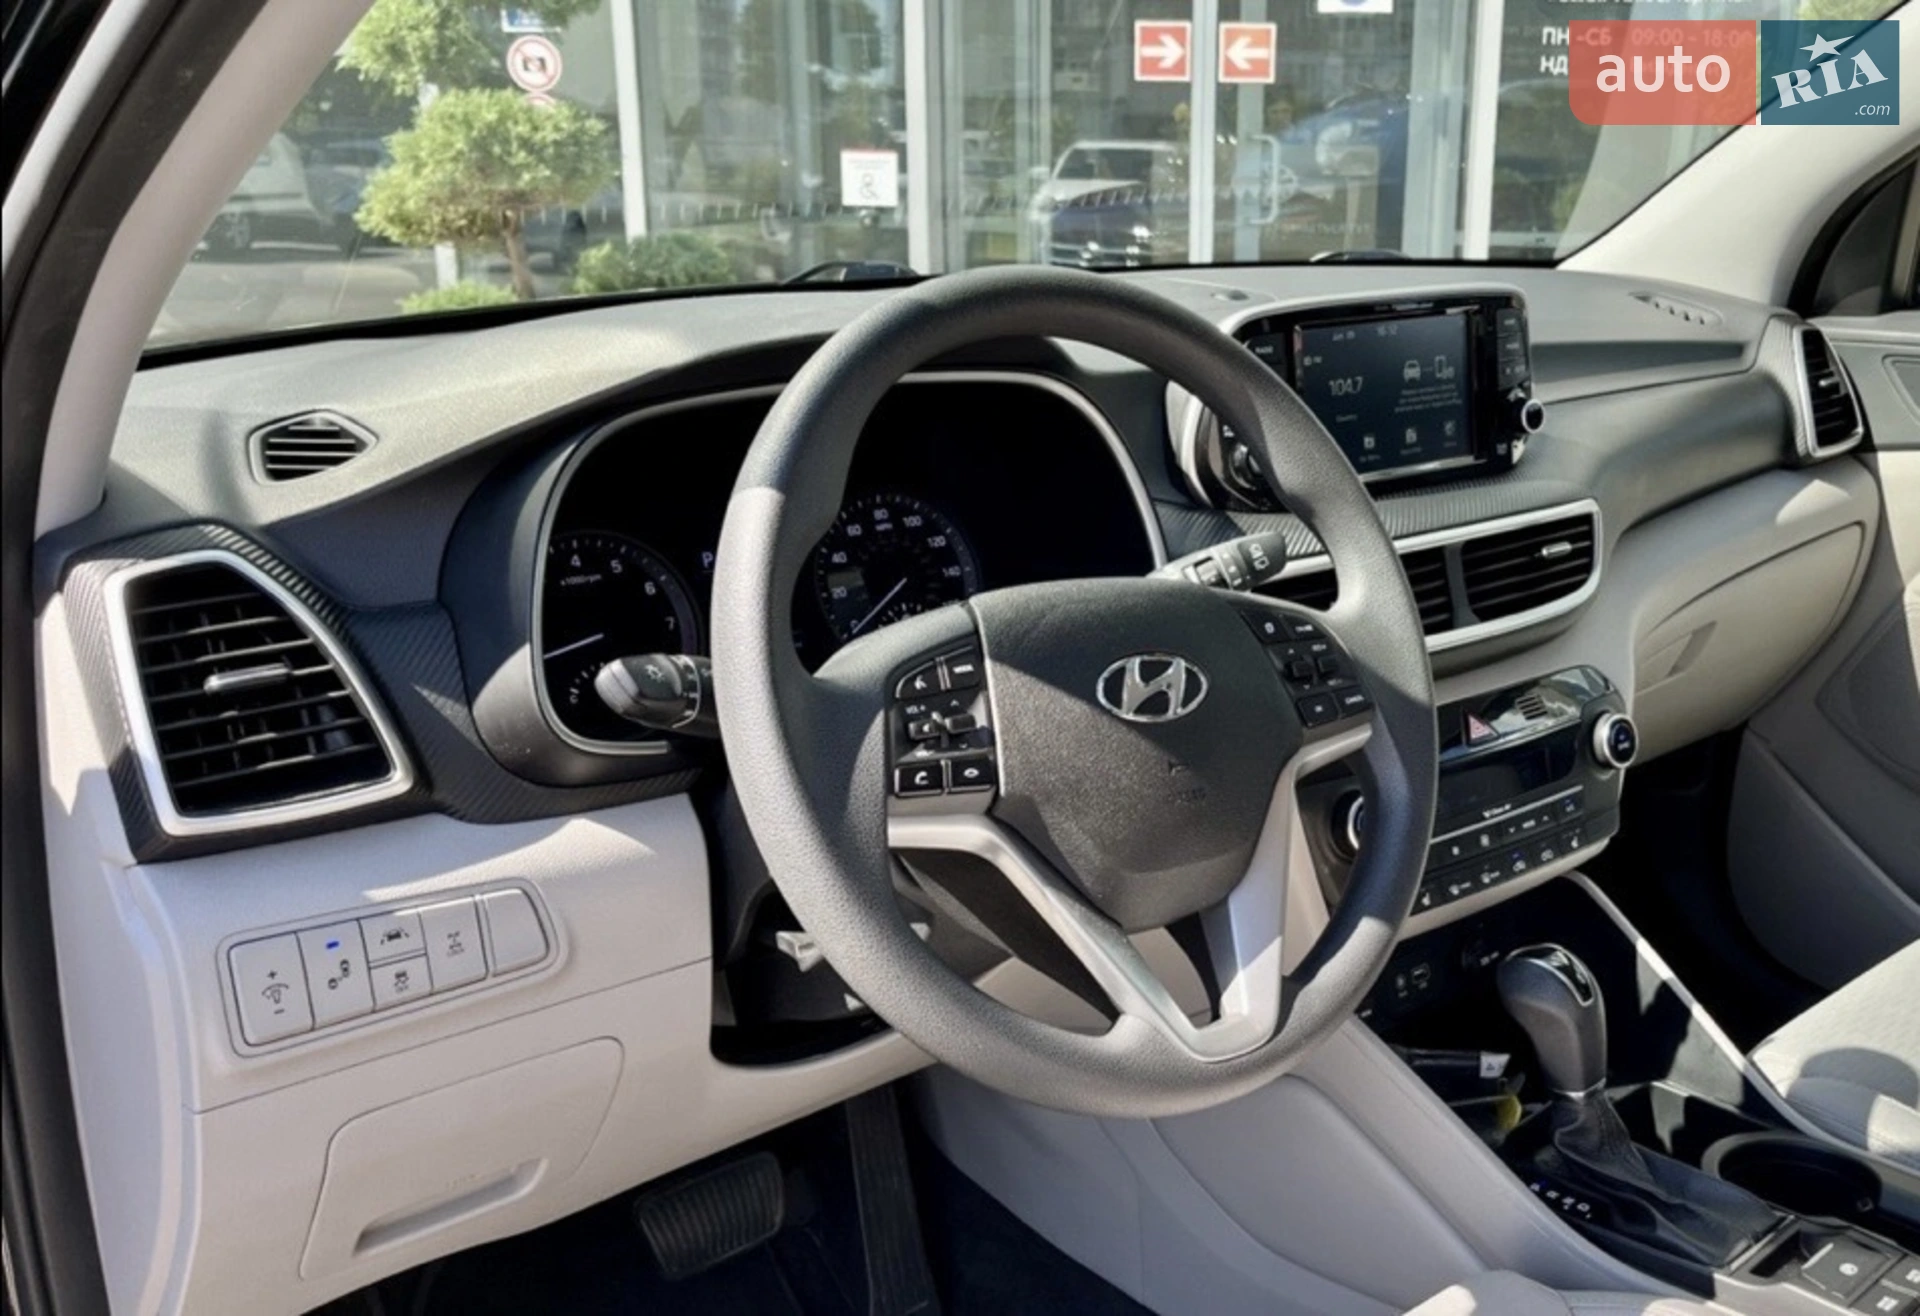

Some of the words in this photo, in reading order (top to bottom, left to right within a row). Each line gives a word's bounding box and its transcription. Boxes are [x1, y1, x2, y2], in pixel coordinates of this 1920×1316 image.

[873, 508, 889, 521] 80
[902, 515, 923, 528] 100
[846, 523, 863, 537] 60
[927, 535, 947, 548] 120
[570, 554, 582, 568] 4
[702, 552, 714, 569] P
[831, 551, 848, 564] 40
[610, 559, 623, 574] 5
[644, 581, 657, 596] 6
[832, 586, 848, 600] 20
[665, 616, 676, 631] 7
